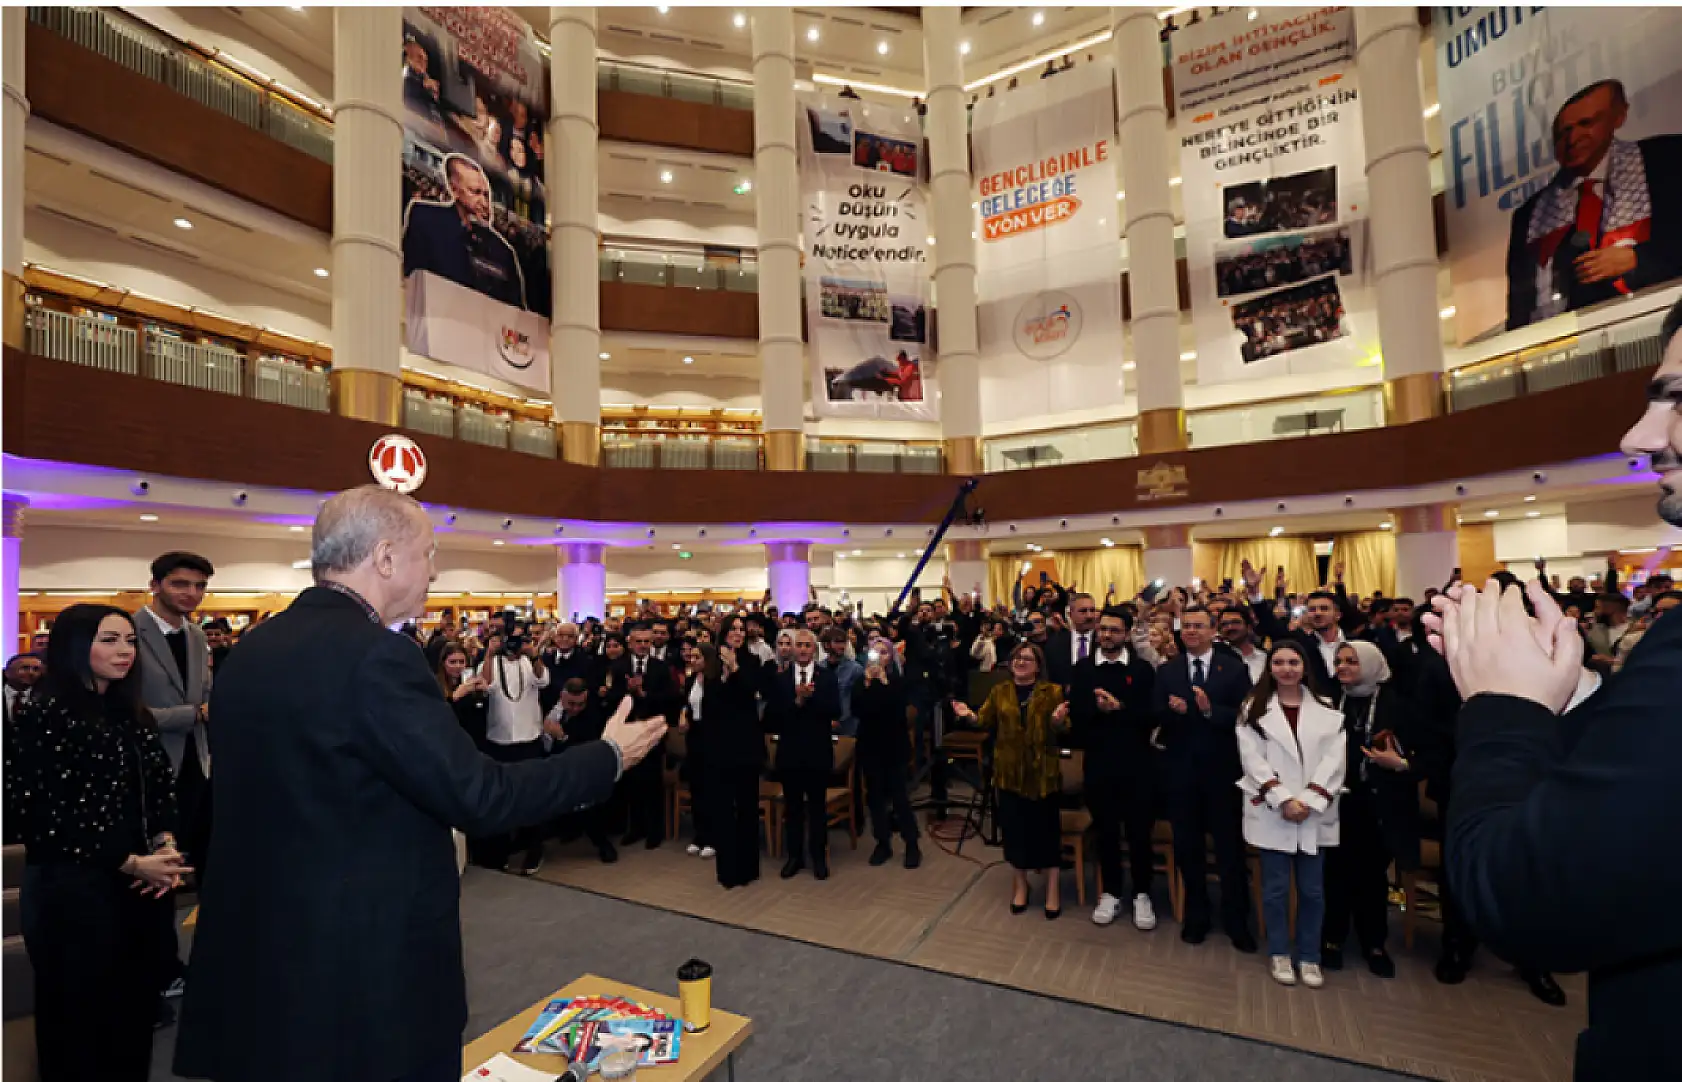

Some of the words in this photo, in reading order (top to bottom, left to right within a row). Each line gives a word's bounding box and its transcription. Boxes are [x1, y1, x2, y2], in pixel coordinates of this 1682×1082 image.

[1190, 50, 1242, 75] OLAN
[848, 183, 886, 199] Oku
[838, 202, 899, 219] Düşün
[1030, 201, 1071, 225] VER
[834, 222, 899, 241] Uygula
